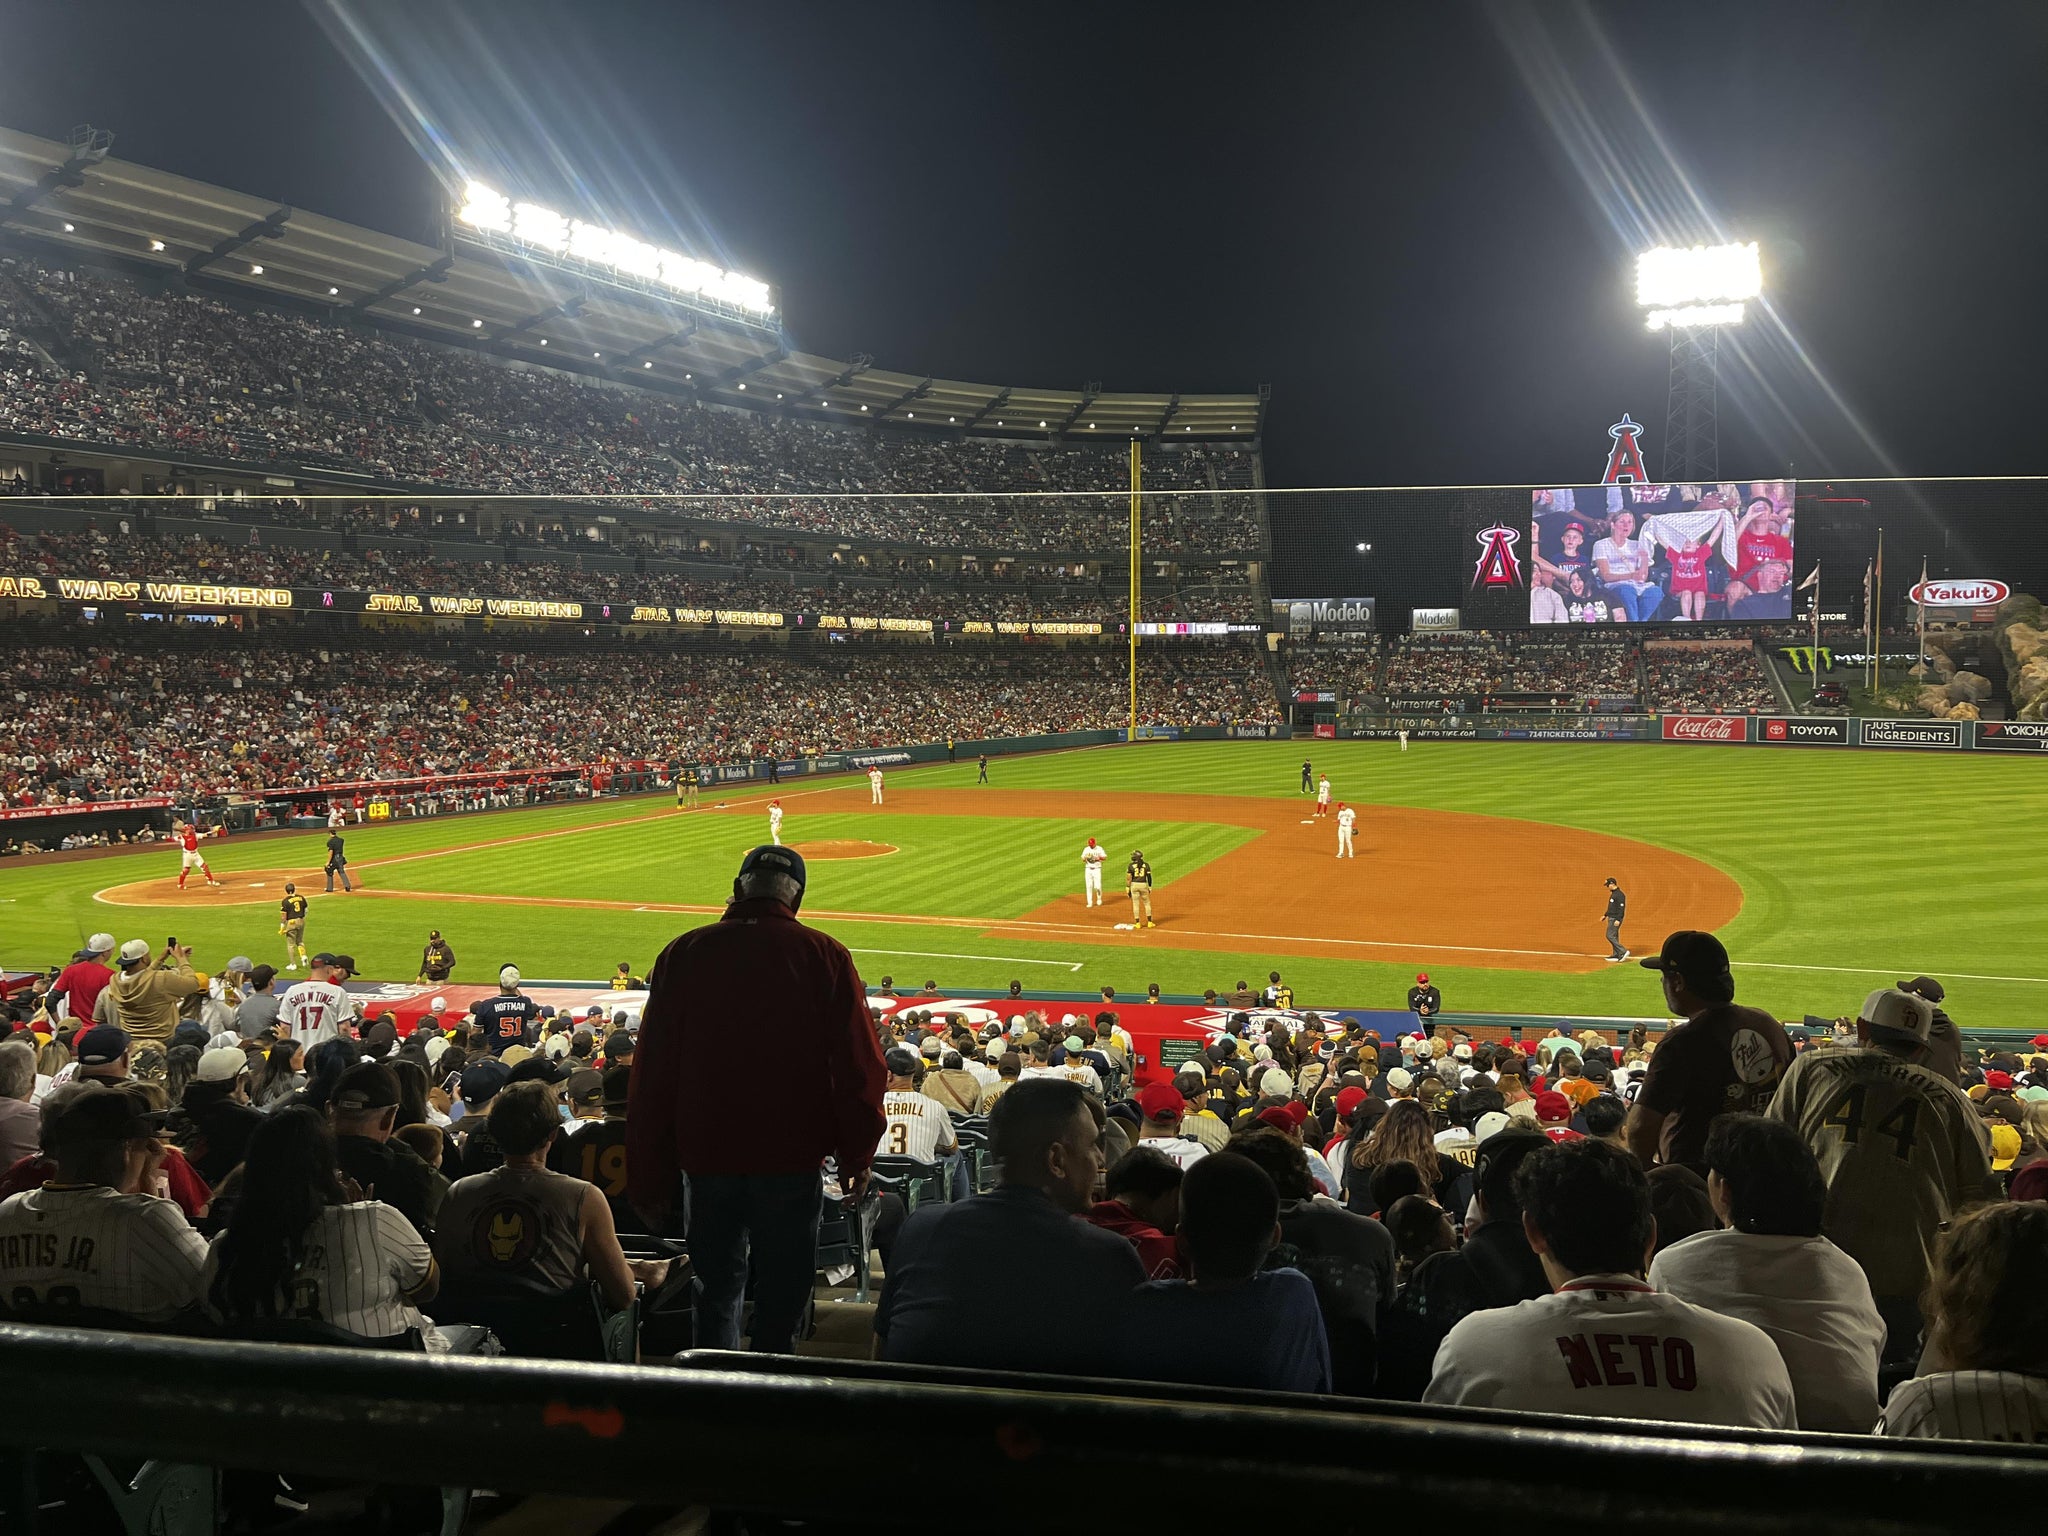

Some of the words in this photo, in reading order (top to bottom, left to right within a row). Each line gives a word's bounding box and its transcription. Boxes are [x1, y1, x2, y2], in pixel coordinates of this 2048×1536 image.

[59, 579, 140, 601] WARS
[149, 582, 292, 607] WEEKEND
[1927, 586, 1994, 600] Yakult
[365, 594, 422, 612] STAR
[429, 596, 483, 613] WARS
[487, 599, 582, 618] WEEKEND
[1313, 601, 1370, 621] Modelo
[631, 607, 670, 621] STAR
[676, 608, 713, 623] WARS
[715, 610, 783, 626] WEEKEND
[818, 616, 847, 628] STAR
[850, 617, 878, 629] WARS
[879, 618, 932, 631] WEEKEND
[1418, 611, 1454, 625] Modelo
[1820, 613, 1847, 621] STORE
[962, 622, 993, 633] STAR
[997, 622, 1030, 633] WARS
[1032, 623, 1101, 634] WEEKEND
[1237, 726, 1265, 737] Modelo
[1672, 717, 1735, 739] Coca-Cola
[1790, 725, 1838, 736] TOYOTA
[1871, 721, 1896, 730] JUST
[1441, 730, 1476, 738] TIRE.COM
[1871, 730, 1950, 742] INGREDIENTS
[584, 765, 612, 776] LNAS
[726, 768, 747, 779] Modelo
[494, 1001, 526, 1013] HOFFMAN
[300, 1006, 324, 1030] 17
[499, 1016, 523, 1038] 51
[886, 1102, 924, 1118] ERRILL
[1823, 1083, 1921, 1164] 44
[889, 1122, 909, 1155] 3
[581, 1143, 627, 1197] 19
[0, 1233, 58, 1269] TATIS
[62, 1235, 97, 1275] JR.
[1555, 1332, 1699, 1392] NETO
